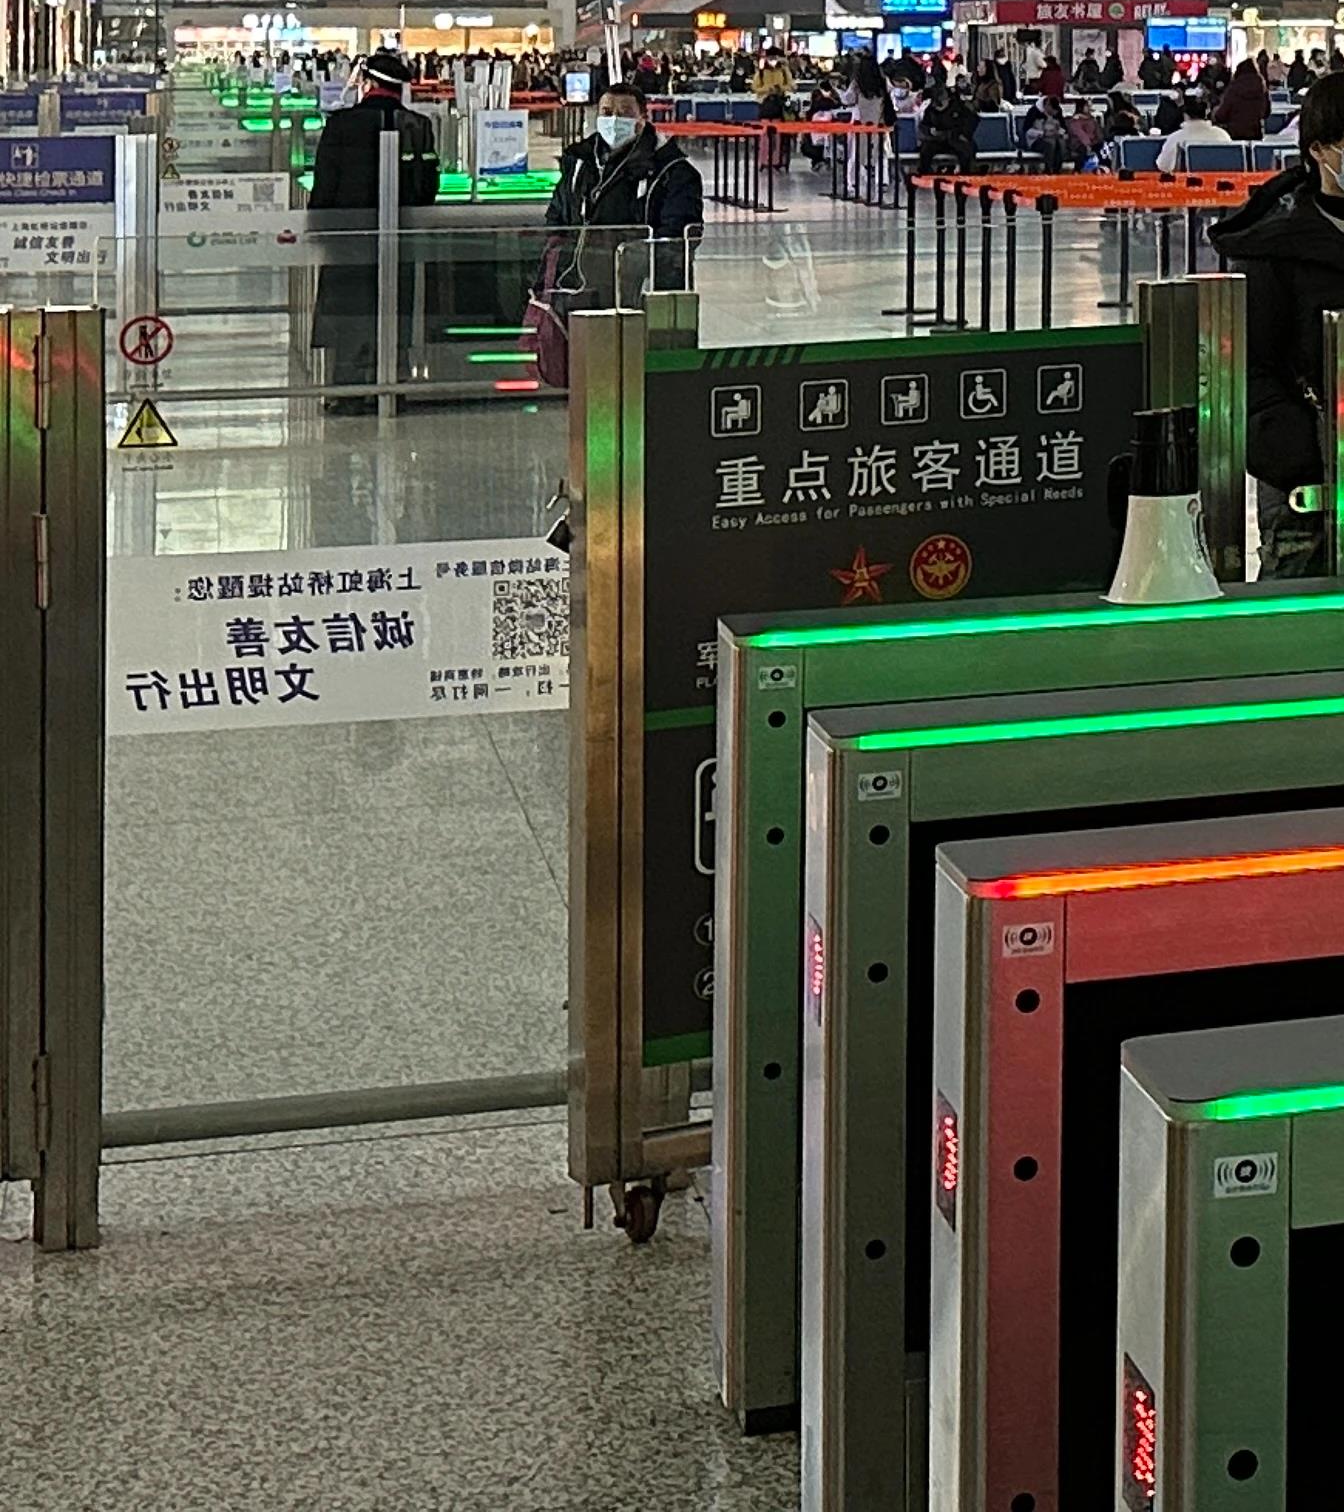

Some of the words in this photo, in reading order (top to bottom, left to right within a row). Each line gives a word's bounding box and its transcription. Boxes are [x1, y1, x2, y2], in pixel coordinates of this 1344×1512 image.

[715, 430, 1084, 509] 重点旅客通道
[712, 514, 747, 531] Easy
[755, 510, 808, 527] Access
[816, 505, 840, 521] for
[849, 498, 933, 519] Passengers
[940, 494, 974, 510] with
[980, 489, 1036, 508] Special
[1044, 485, 1084, 502] Needs
